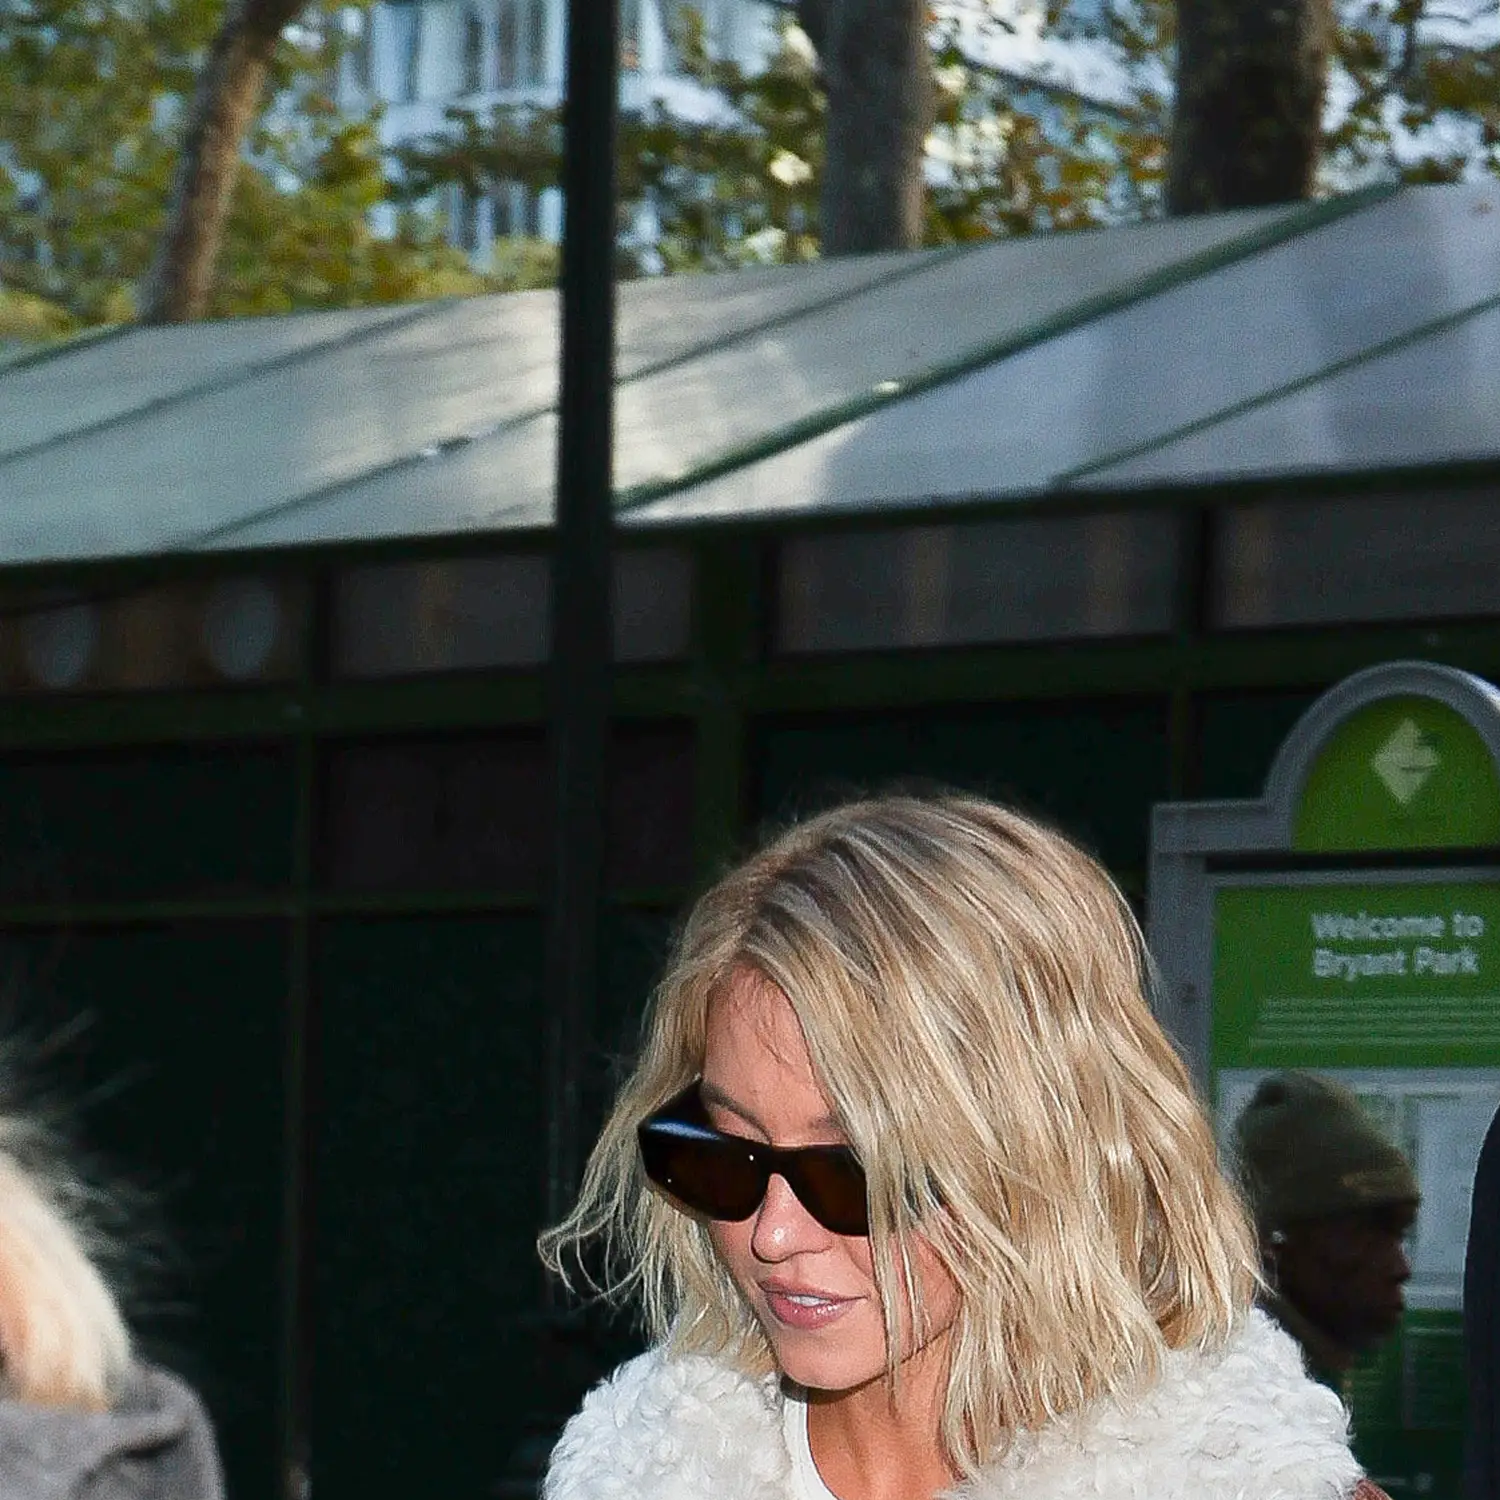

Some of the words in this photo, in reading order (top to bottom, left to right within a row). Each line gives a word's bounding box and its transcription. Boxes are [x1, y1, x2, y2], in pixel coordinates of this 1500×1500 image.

[1312, 911, 1446, 939] Welcome
[1453, 911, 1485, 938] to
[1313, 947, 1406, 981] Bryant
[1414, 946, 1479, 976] Park
